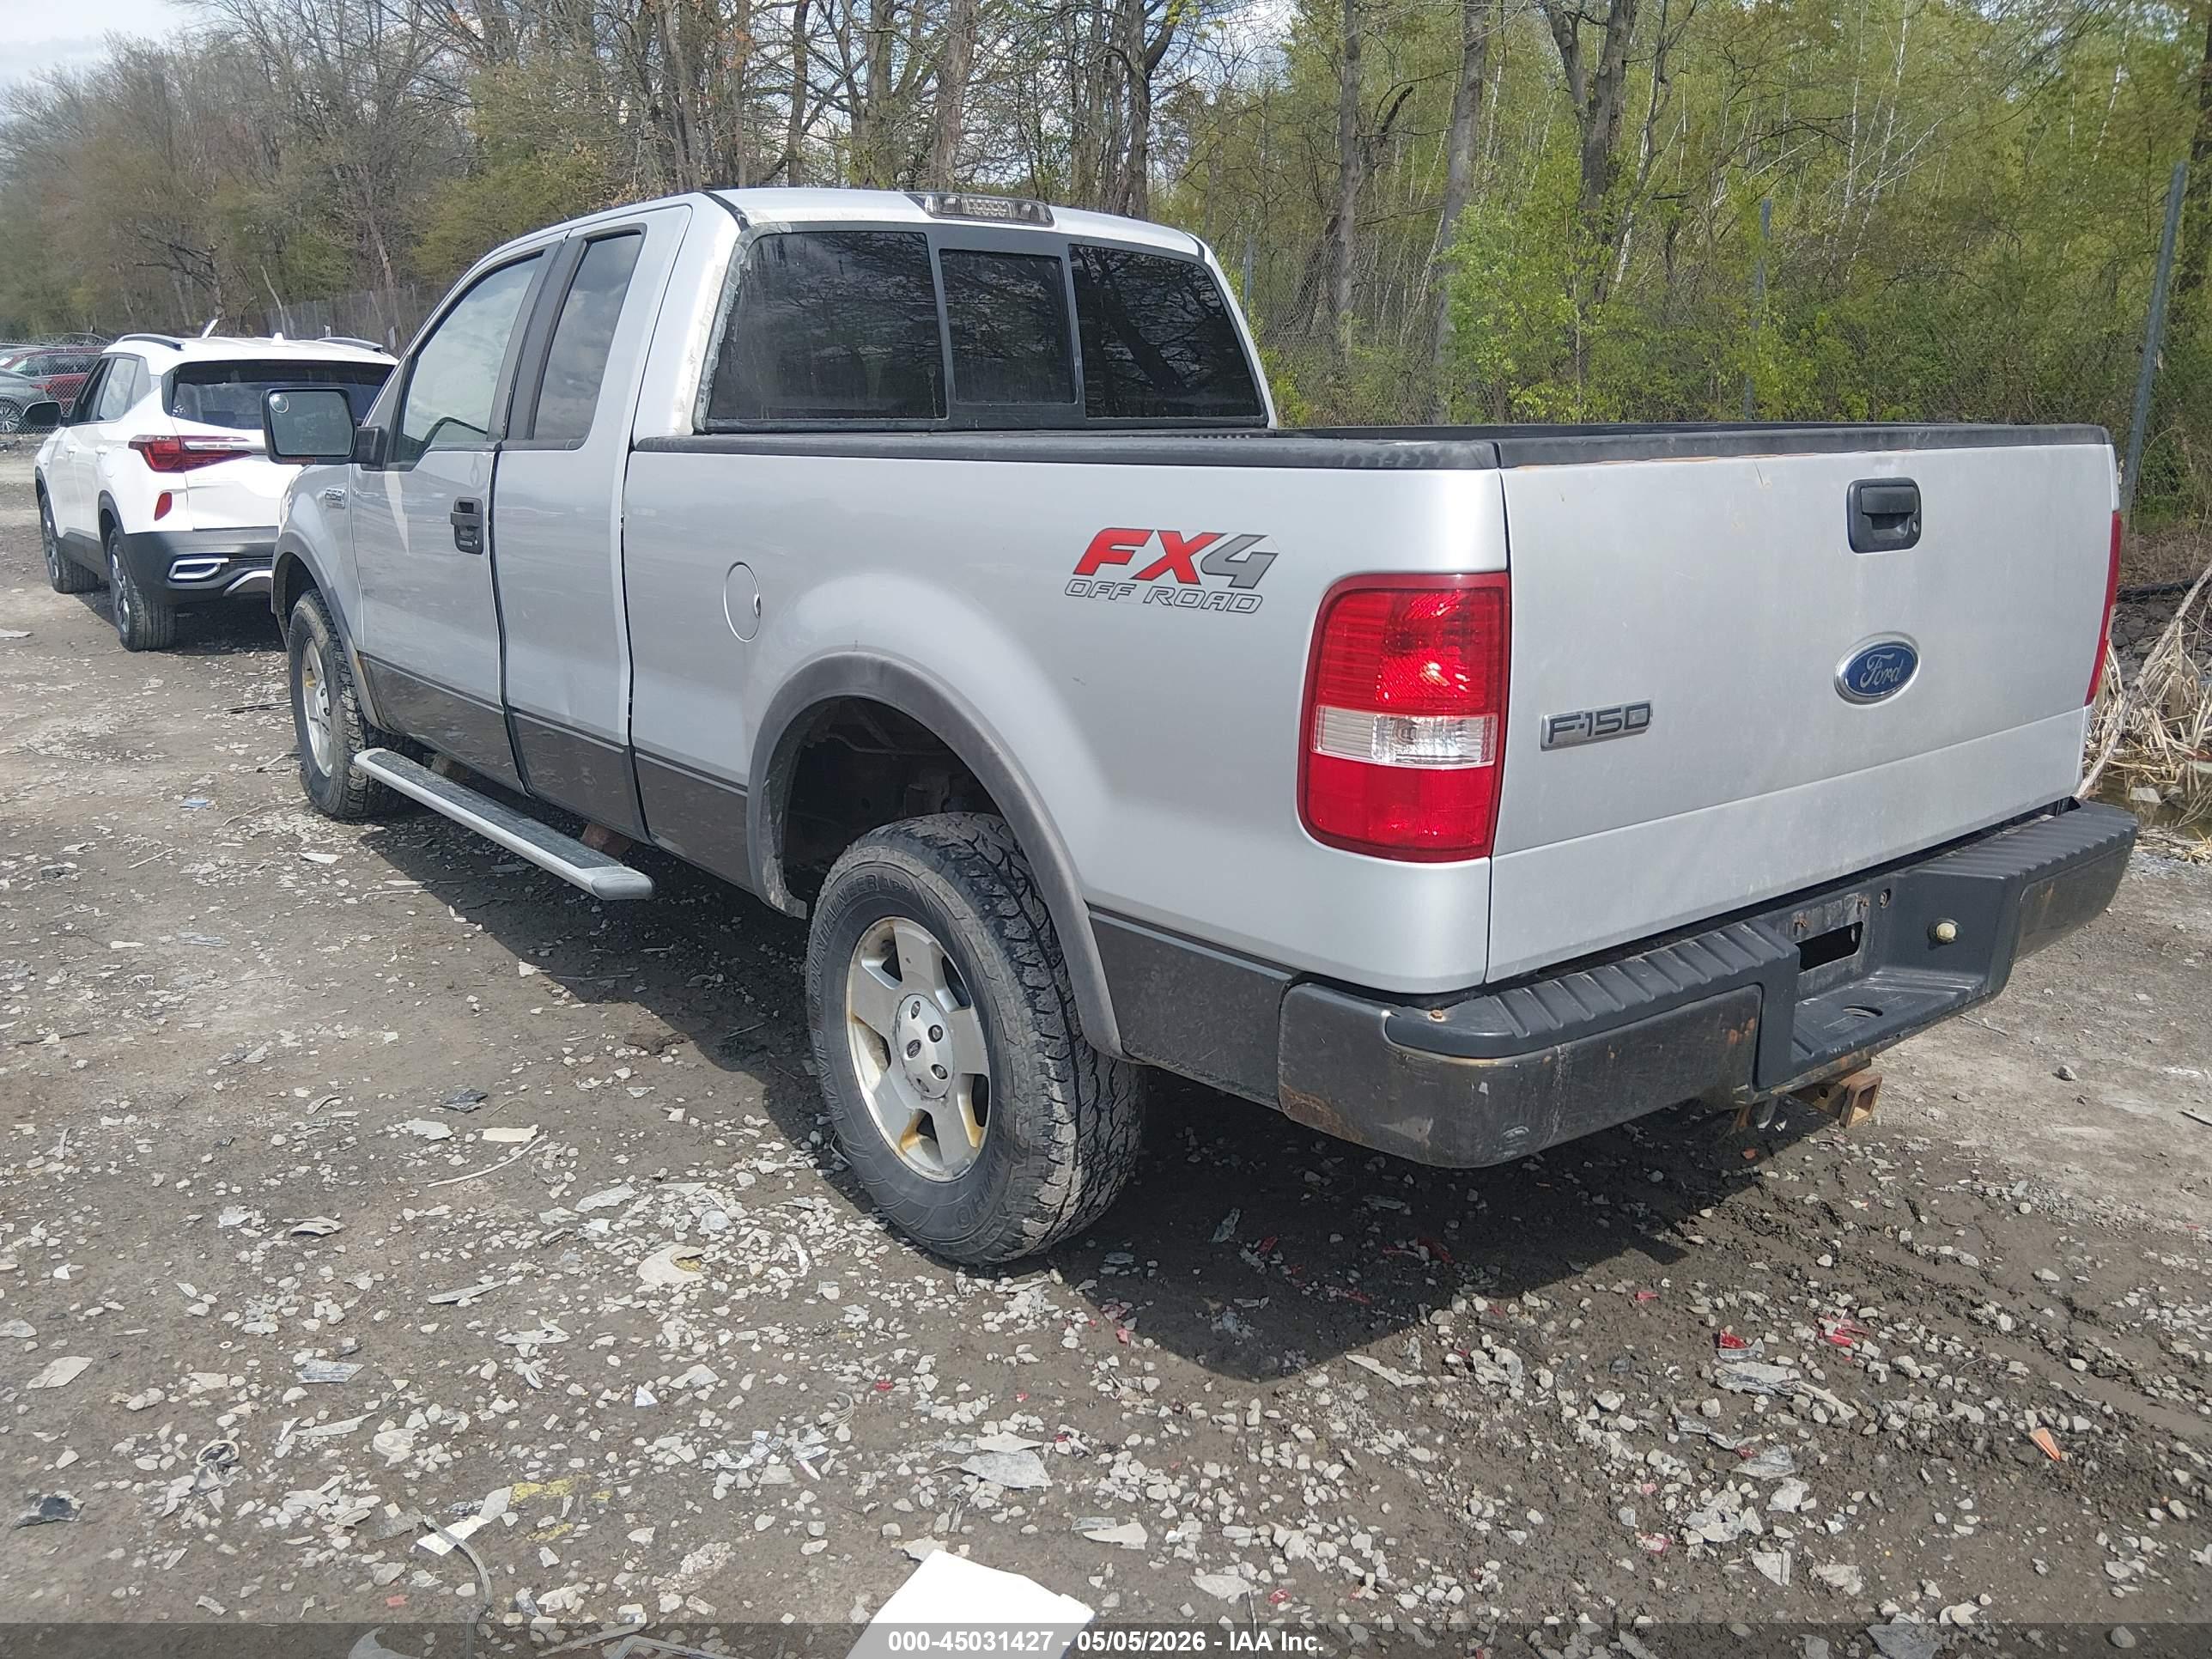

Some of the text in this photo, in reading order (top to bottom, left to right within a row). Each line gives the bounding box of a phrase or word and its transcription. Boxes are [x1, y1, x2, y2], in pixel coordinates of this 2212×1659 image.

[1073, 527, 1279, 589] FX4
[1065, 578, 1263, 614] OFF ROAD
[1859, 653, 1904, 688] Ford
[1547, 702, 1651, 744] F-150
[813, 1029, 846, 1121] MAVIS
